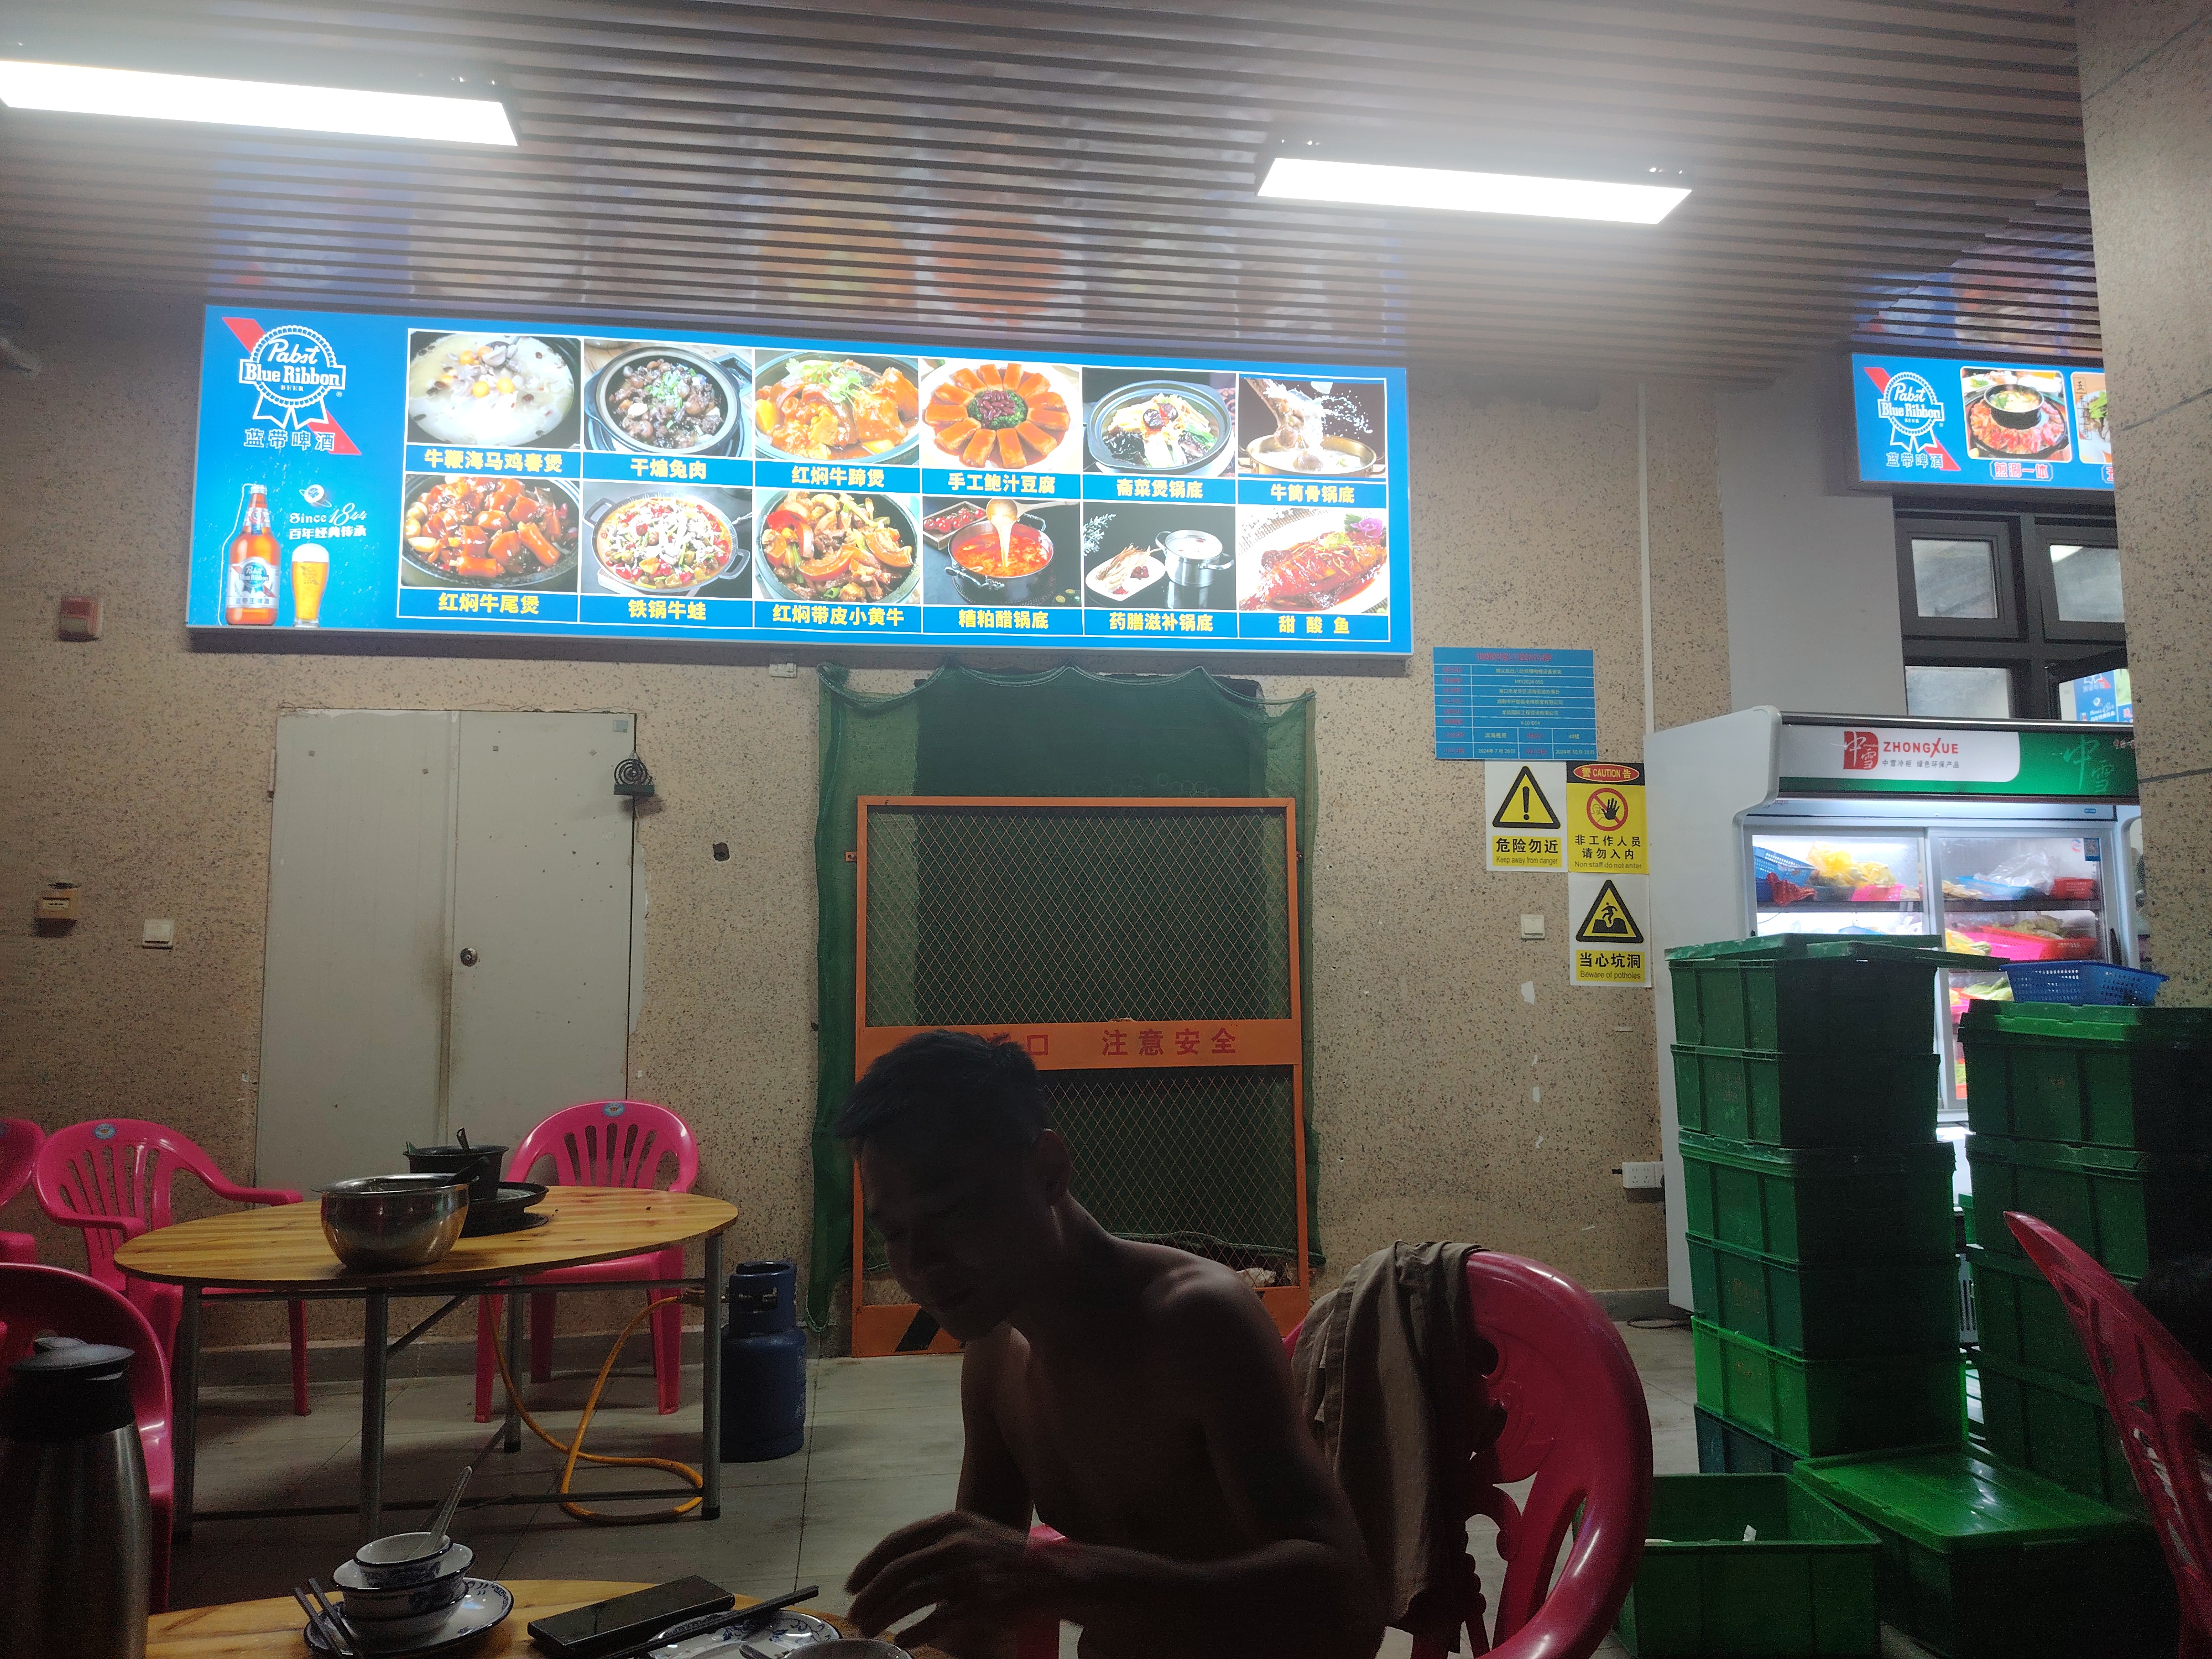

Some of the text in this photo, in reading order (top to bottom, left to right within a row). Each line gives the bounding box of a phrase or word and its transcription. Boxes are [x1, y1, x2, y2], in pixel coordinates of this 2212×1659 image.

[268, 338, 320, 364] Pabst
[244, 363, 340, 386] Blue Ribbon
[1892, 382, 1926, 403] Pabst
[1881, 402, 1941, 419] Blue Ribbon
[243, 428, 335, 451] 蓝带啤酒
[424, 448, 563, 473] 牛鞭海马鸡春煲
[630, 458, 707, 480] 干煸兔肉
[1886, 452, 1943, 468] 蓝带啤酒
[791, 465, 885, 488] 红焖牛蹄煲
[1995, 462, 2049, 479] 煎涮一体
[947, 472, 1056, 494] 手工鲍汁豆腐
[1270, 483, 1355, 504] 牛筒骨锅底
[289, 502, 367, 526] Since 1844
[289, 525, 367, 540] 百年经典传承
[438, 592, 539, 615] 红焖牛尾煲
[628, 599, 707, 620] 铁锅牛蛙
[772, 604, 905, 627] 红焖带皮小黄牛
[958, 610, 1049, 629] 糟粕醋锅底
[1109, 612, 1213, 632] 药膳滋补锅底
[1884, 738, 1959, 758] ZHONGXUE
[1593, 768, 1621, 778] CAUTION
[1623, 769, 1631, 779] 告
[1882, 759, 1960, 769] 中雪冷柜 绿色环保产品
[1496, 837, 1558, 854] 危险勿近
[1575, 834, 1641, 847] 非工作人员
[1496, 855, 1510, 865] Keep
[1539, 857, 1558, 867] danger
[1582, 848, 1634, 860] 请勿入内
[1580, 952, 1641, 968] 当心坑洞
[1101, 1027, 1237, 1056] 注意安全
